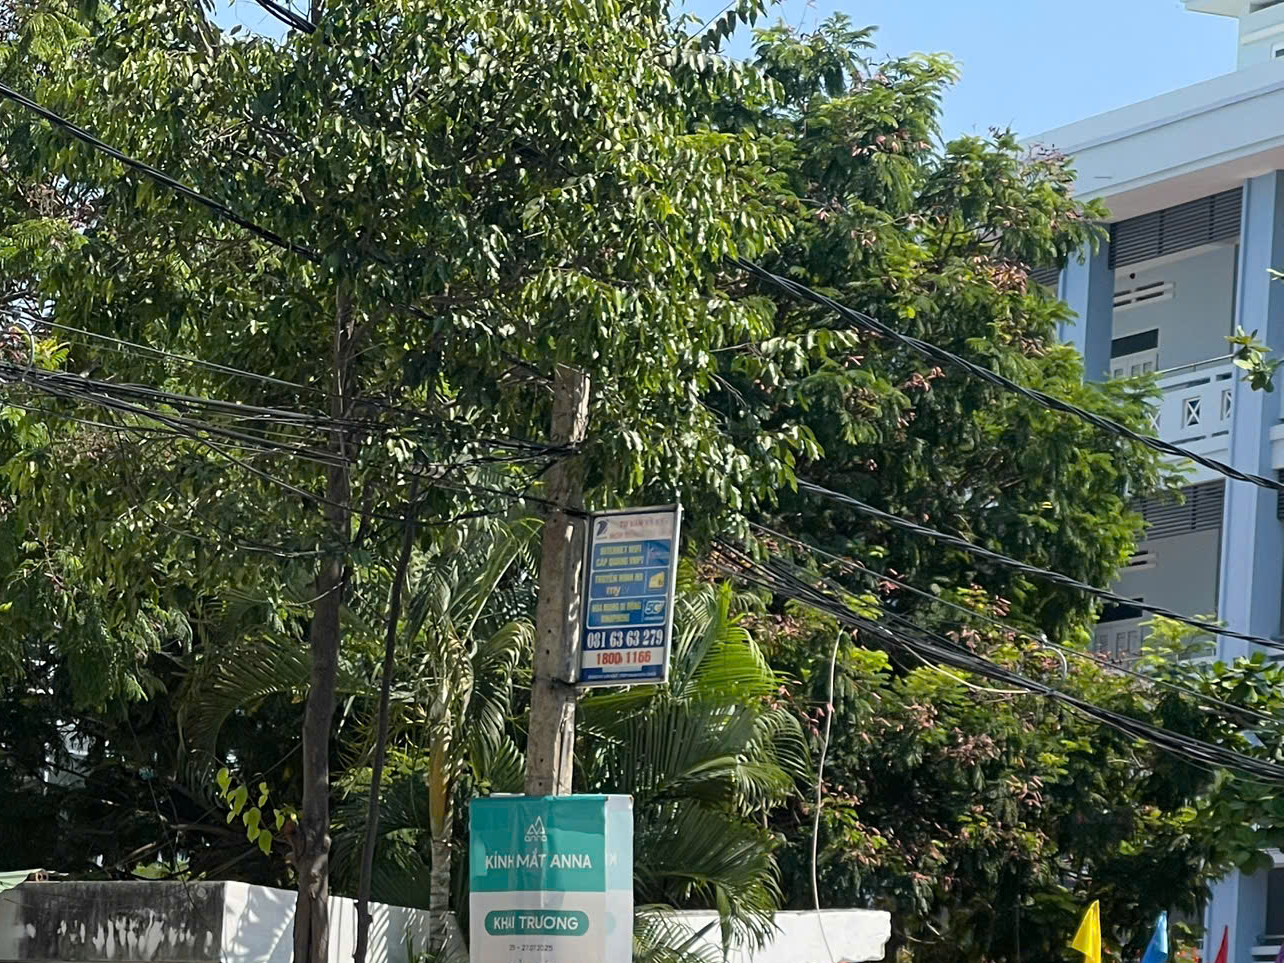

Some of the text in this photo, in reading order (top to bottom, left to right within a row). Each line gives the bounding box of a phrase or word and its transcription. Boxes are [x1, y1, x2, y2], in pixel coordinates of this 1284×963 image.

[587, 629, 664, 649] 081 63 63 279
[596, 650, 652, 666] 1800 1166
[485, 848, 592, 869] KÍNH MẮT ANNA
[519, 914, 578, 930] TRƯƠNG
